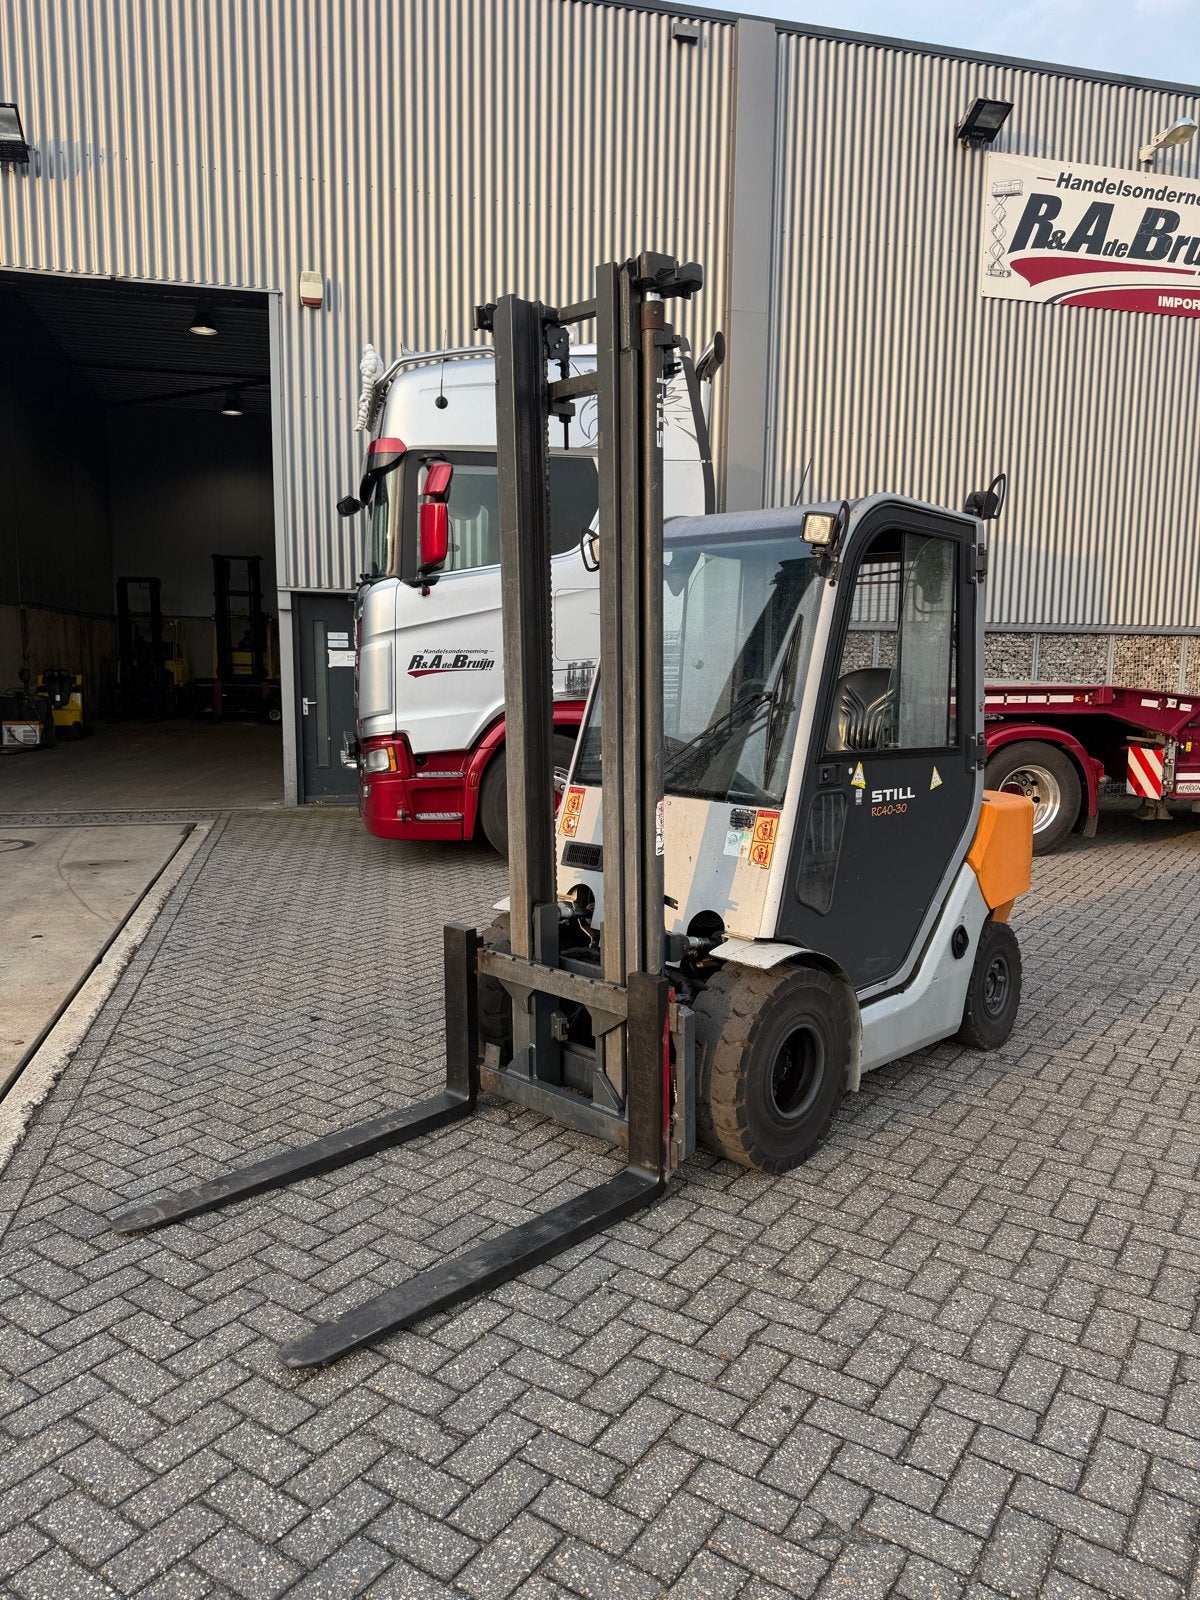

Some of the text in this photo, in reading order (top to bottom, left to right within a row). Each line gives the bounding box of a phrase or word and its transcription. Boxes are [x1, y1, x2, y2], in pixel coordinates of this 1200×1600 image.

[1102, 238, 1128, 258] de
[408, 654, 442, 670] R&A
[452, 654, 495, 671] Bruijn
[872, 787, 915, 802] STILL
[872, 803, 908, 816] RC40-30
